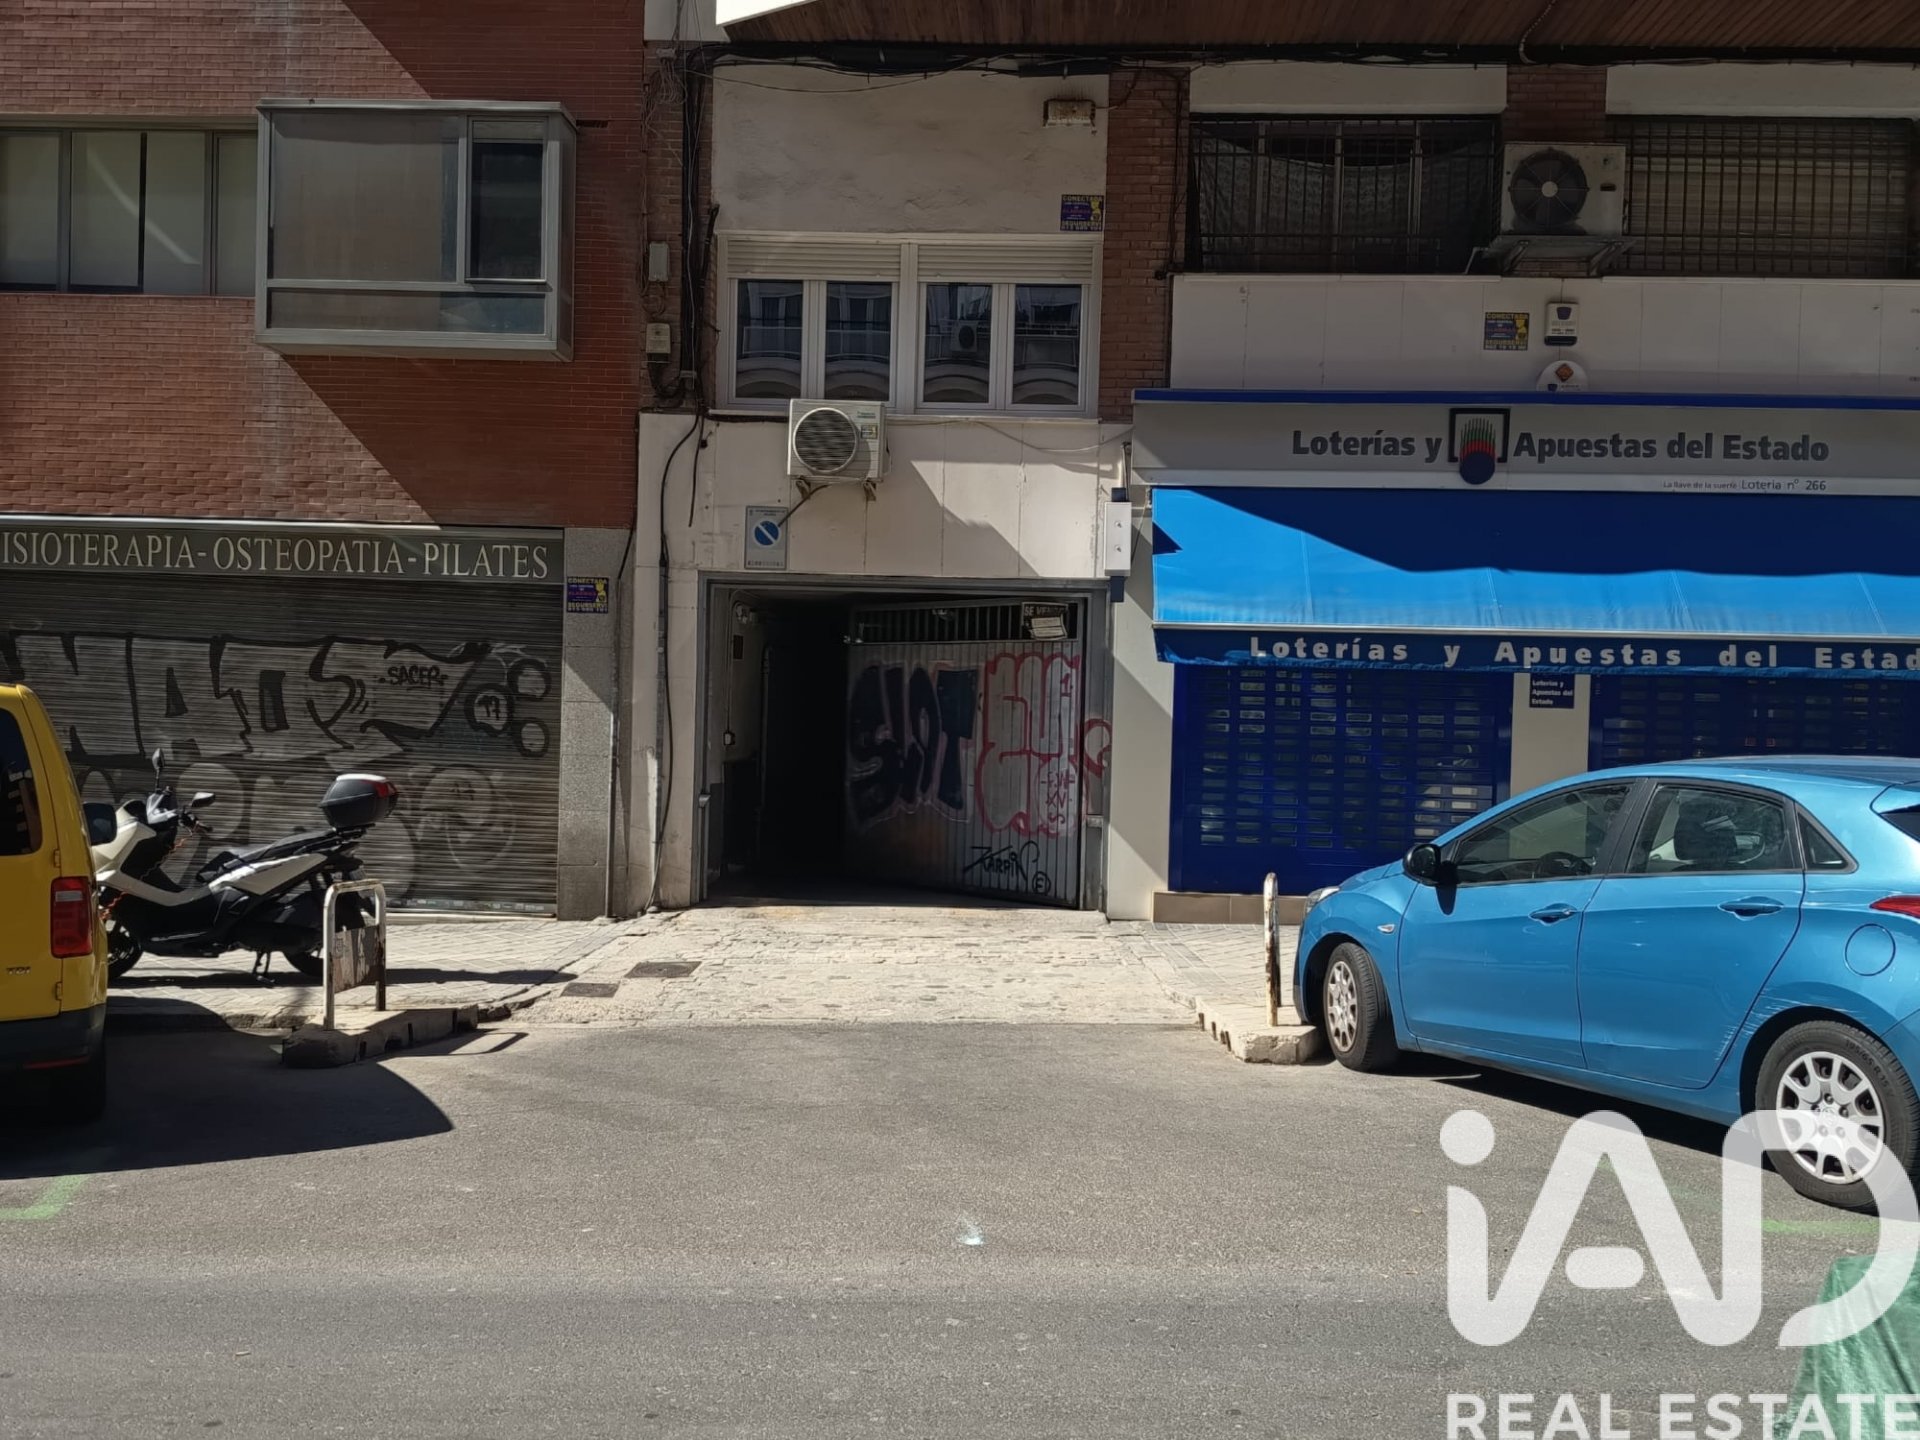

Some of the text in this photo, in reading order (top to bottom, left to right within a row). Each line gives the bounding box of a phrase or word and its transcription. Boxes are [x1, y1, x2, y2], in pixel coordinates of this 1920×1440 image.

[1292, 430, 1829, 463] Loterías y Apuestas del Estado
[1806, 480, 1827, 491] 266
[1250, 637, 1408, 660] Loterías
[1444, 644, 1461, 667] y
[1494, 642, 1682, 669] Apuestas
[1719, 644, 1777, 667] del
